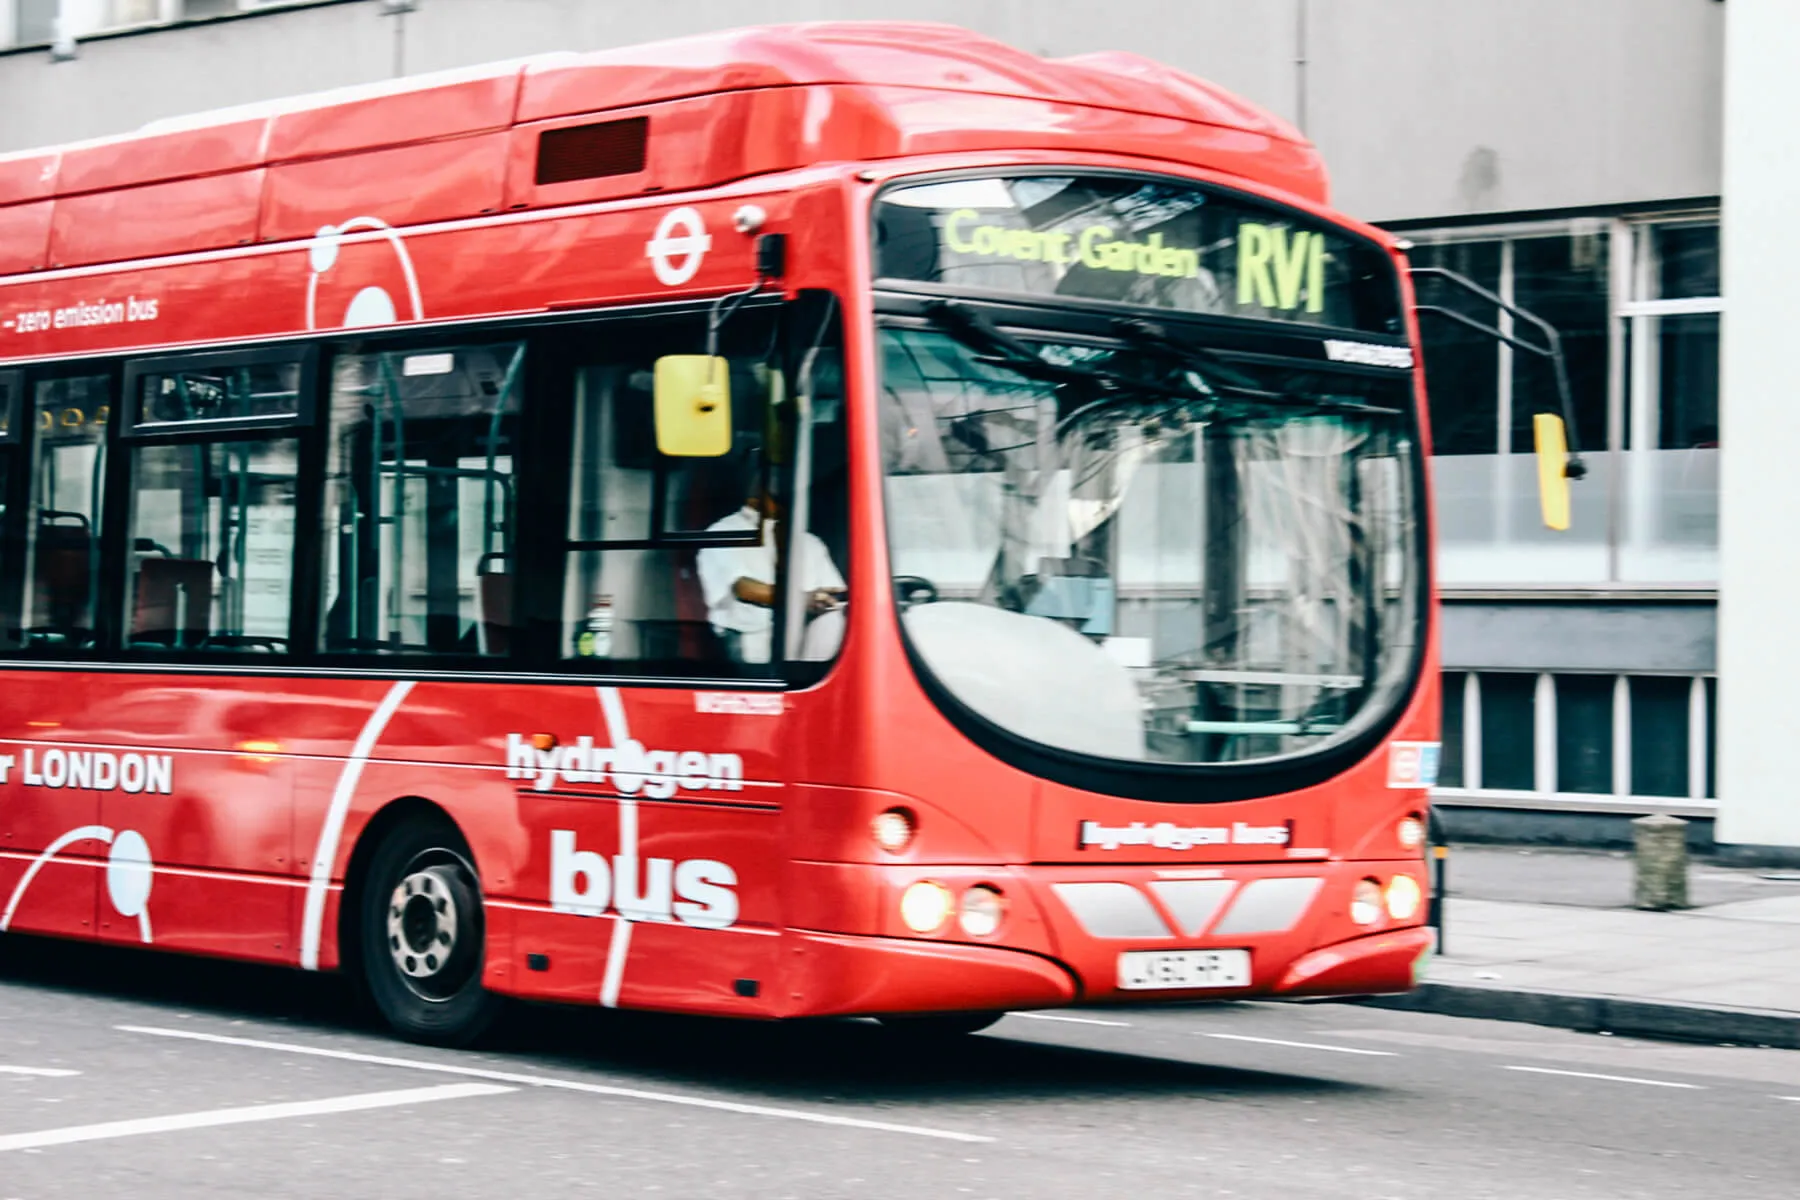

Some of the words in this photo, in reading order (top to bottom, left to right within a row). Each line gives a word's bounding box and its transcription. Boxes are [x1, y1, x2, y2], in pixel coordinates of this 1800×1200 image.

[944, 209, 1071, 263] Covent
[1078, 225, 1198, 279] Garden
[16, 310, 51, 333] zero
[53, 298, 125, 328] emission
[127, 295, 159, 321] bus
[23, 748, 173, 794] LONDON
[506, 732, 744, 800] hydrogen
[550, 829, 740, 930] bus
